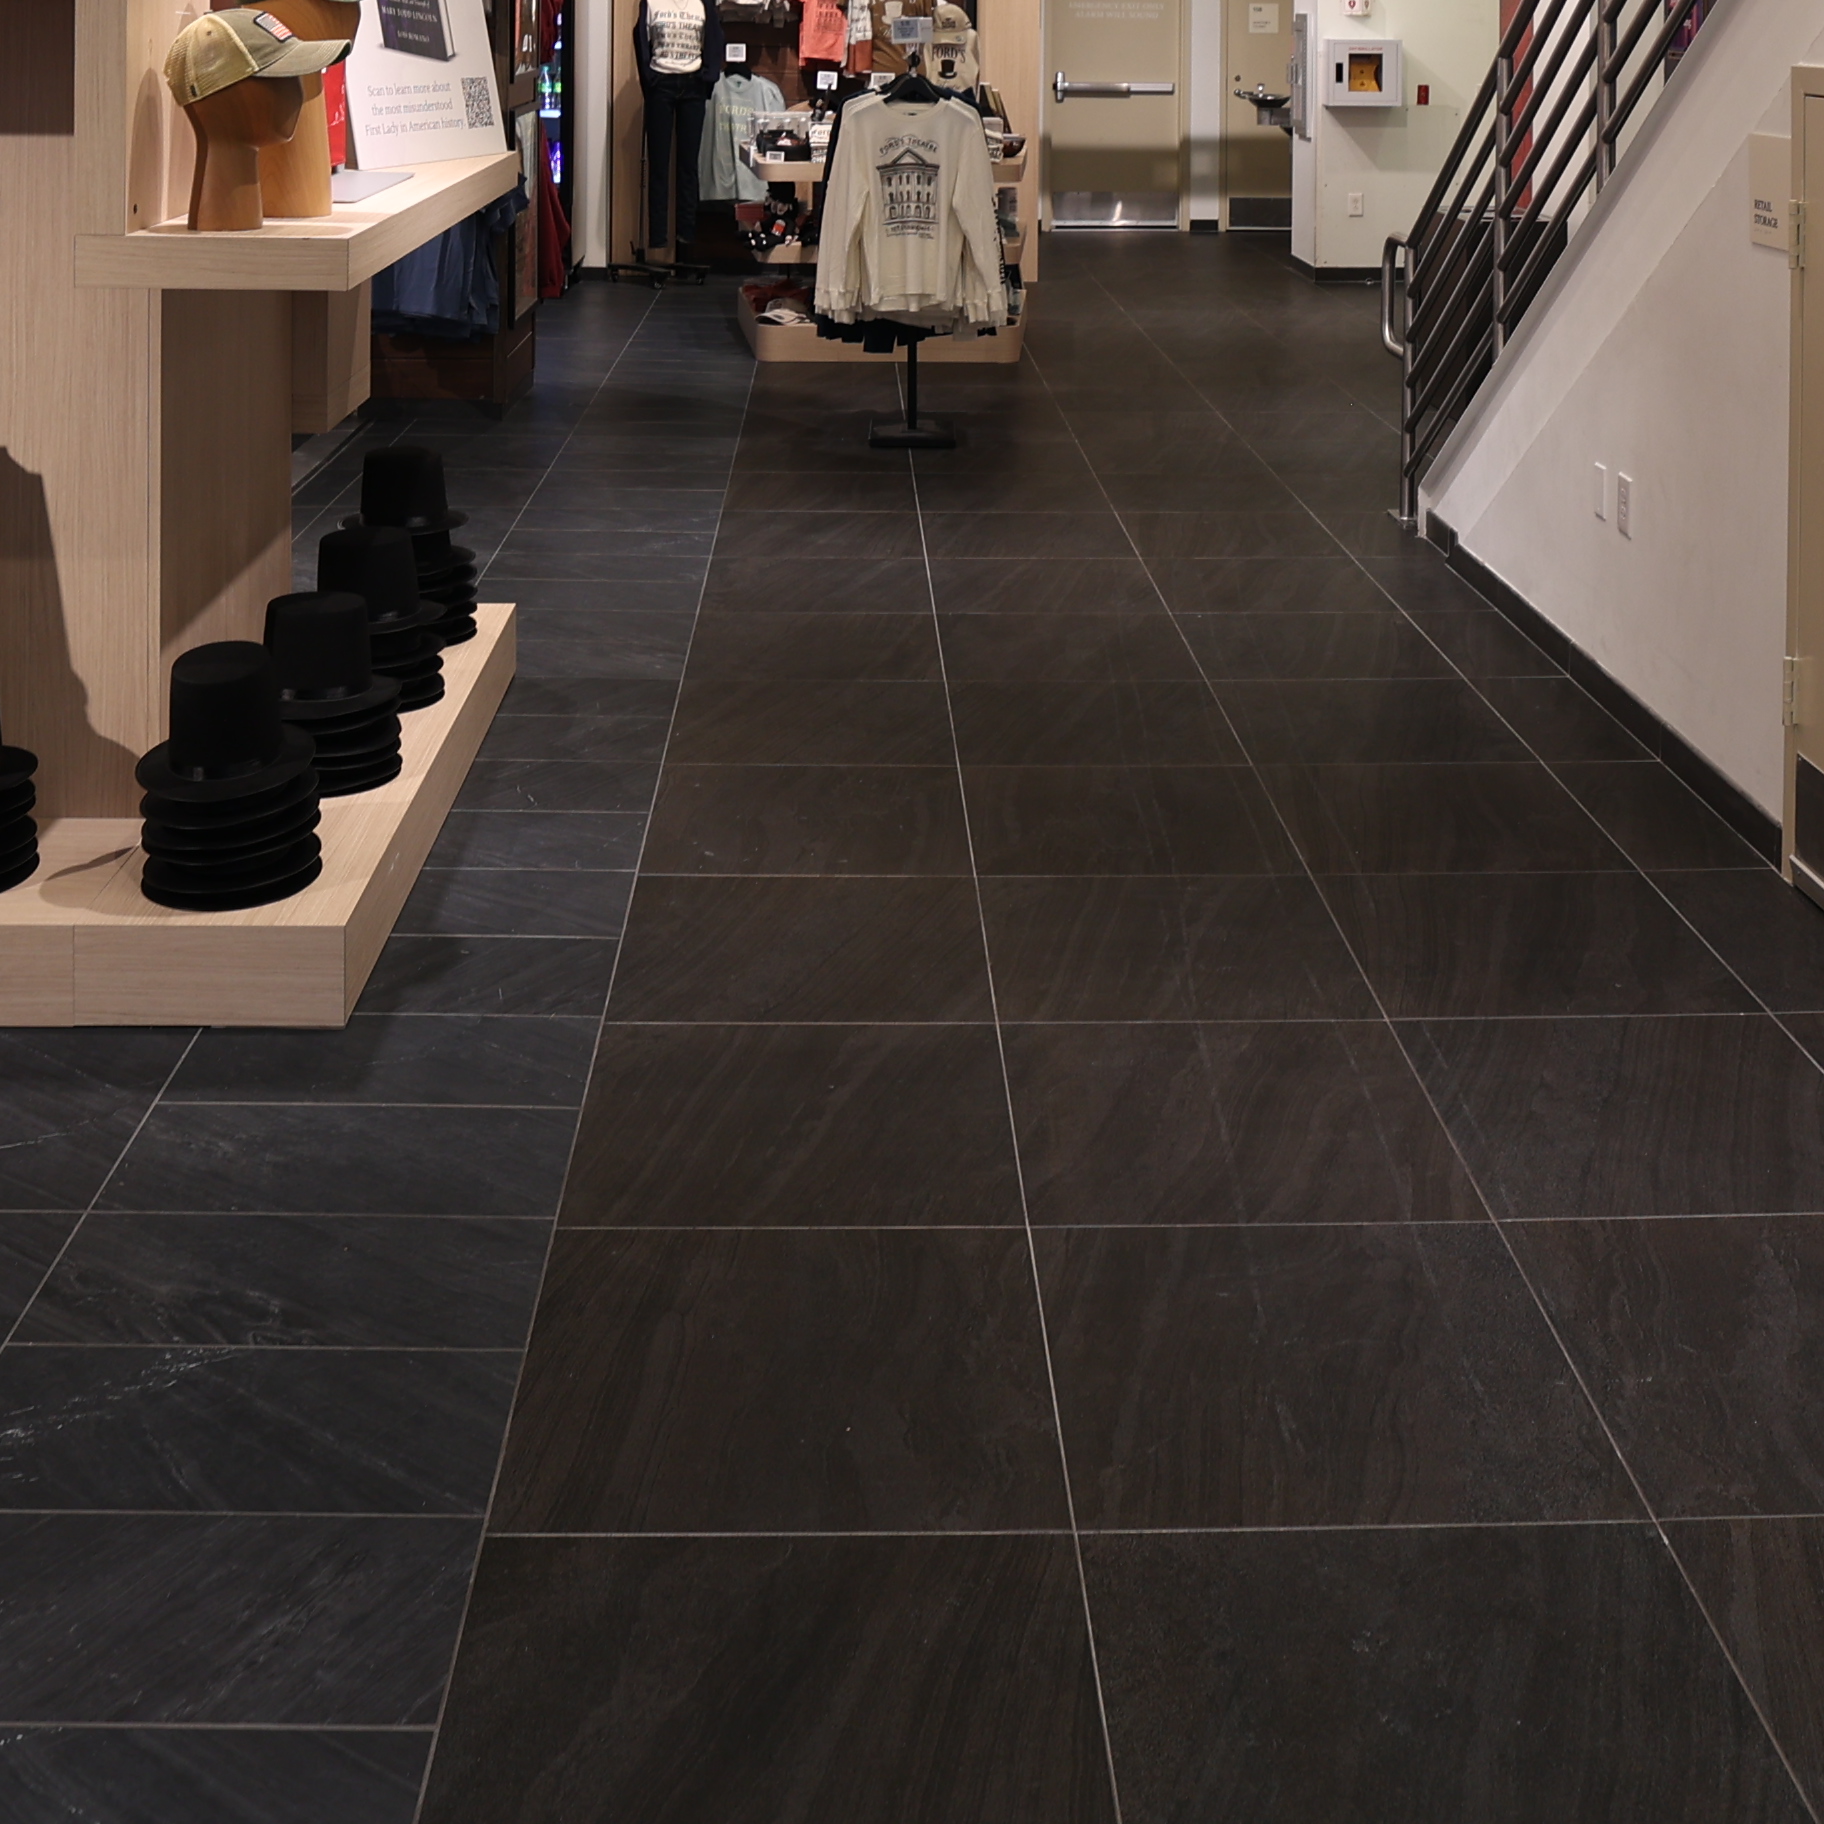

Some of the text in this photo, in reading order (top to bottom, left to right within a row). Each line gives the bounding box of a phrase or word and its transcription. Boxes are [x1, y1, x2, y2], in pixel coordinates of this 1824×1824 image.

[1069, 1, 1164, 10] EMERGENCY EXIT ONLY
[381, 5, 395, 17] MARY
[412, 10, 438, 23] LINCOLN
[1075, 11, 1159, 19] ALARM WILL SOUND
[931, 45, 966, 64] FORD'S
[367, 81, 451, 97] Scan to learn more about
[371, 100, 453, 116] the most misunderstood
[365, 117, 465, 137] First Lady in American history.
[1754, 199, 1773, 213] RETAIL
[1753, 214, 1779, 229] STORAGE
